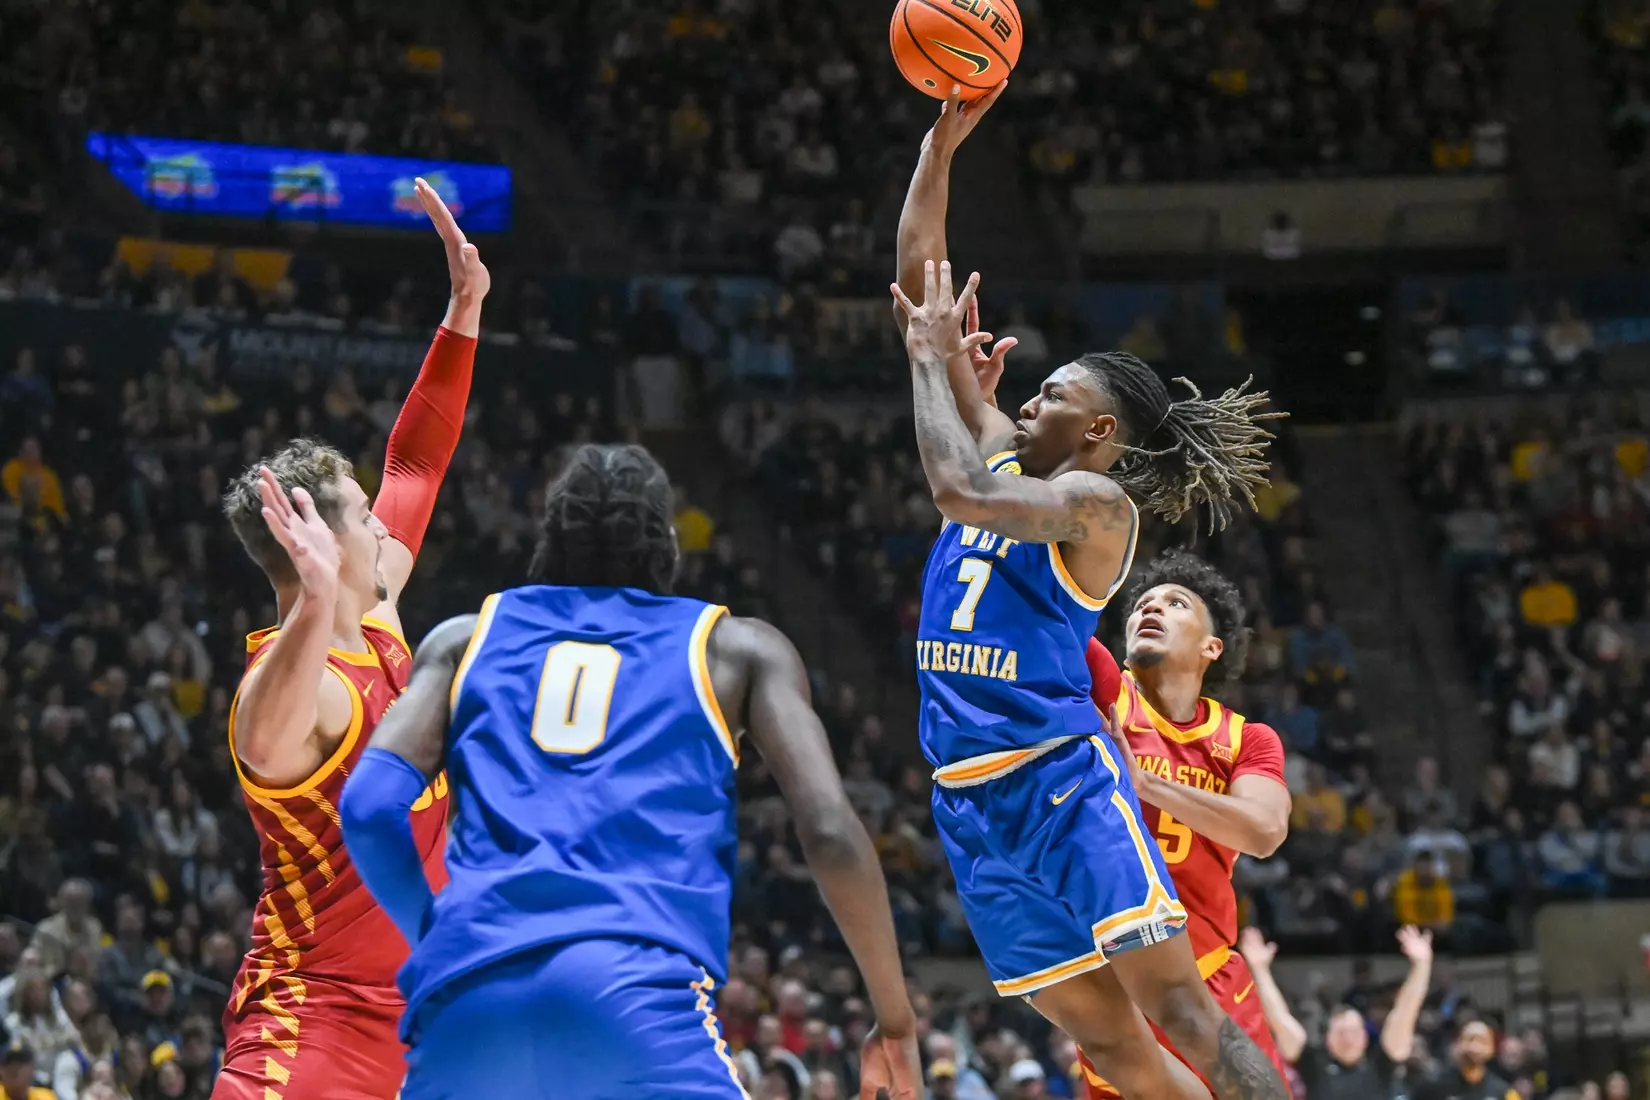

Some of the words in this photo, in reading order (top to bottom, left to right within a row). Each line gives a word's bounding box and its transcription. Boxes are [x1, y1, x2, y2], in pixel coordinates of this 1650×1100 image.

[950, 558, 993, 632] 7
[531, 640, 622, 754] 0
[1136, 755, 1172, 782] WA
[1176, 764, 1231, 796] STAT
